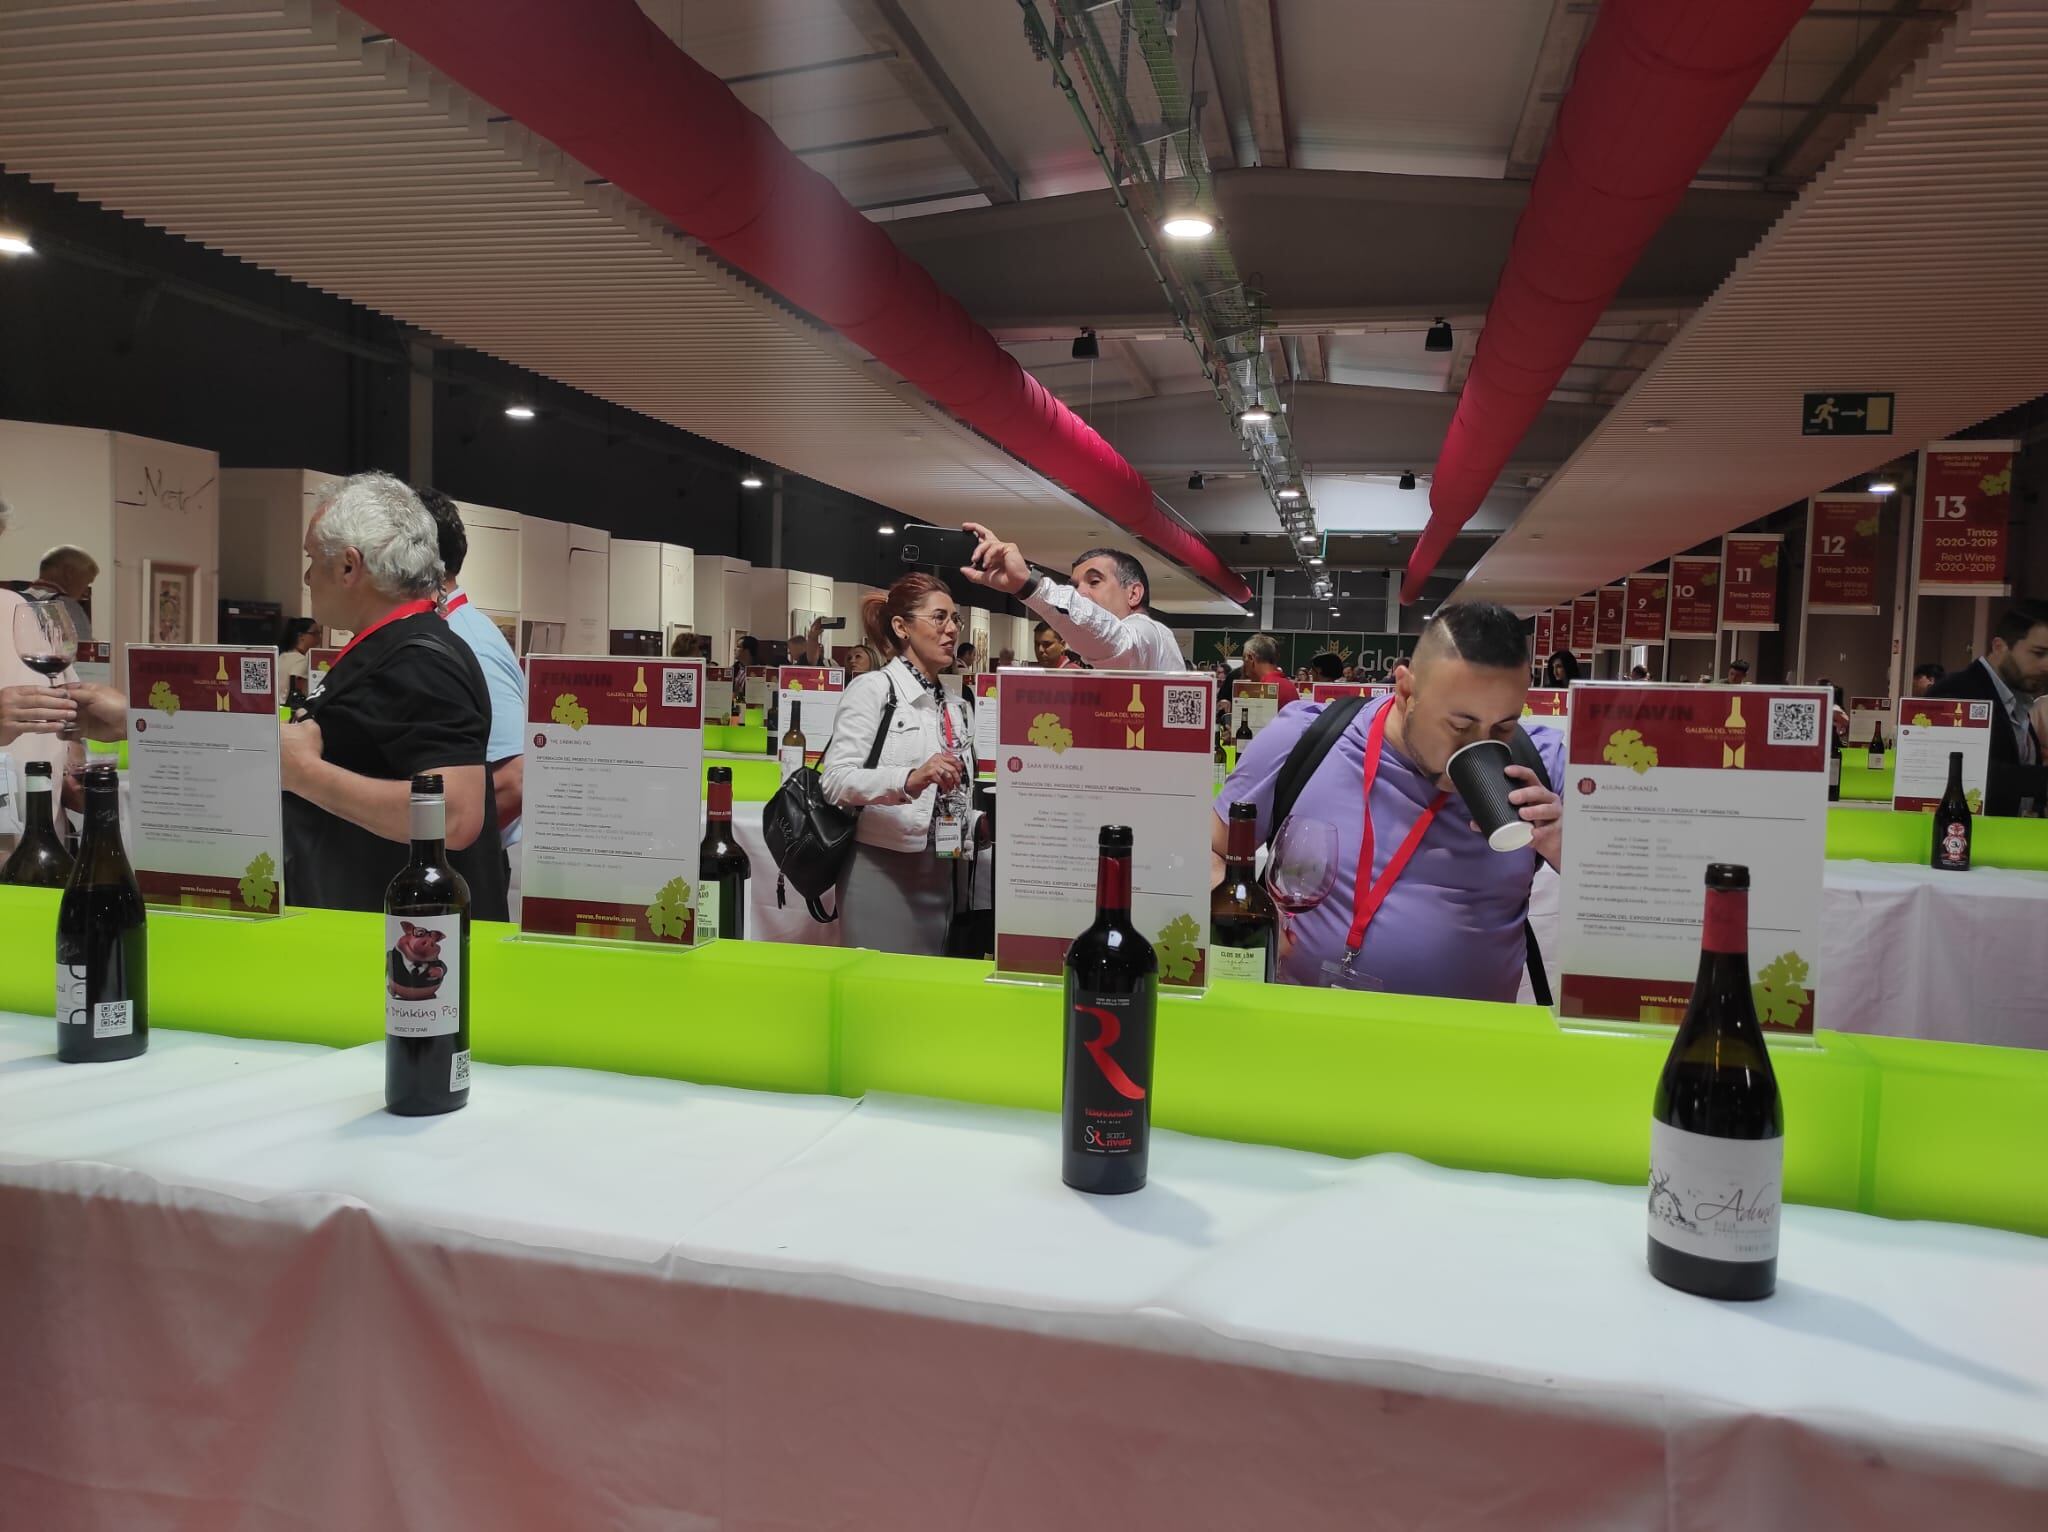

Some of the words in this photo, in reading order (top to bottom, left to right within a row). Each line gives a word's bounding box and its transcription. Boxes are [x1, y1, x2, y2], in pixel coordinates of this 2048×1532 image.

[1935, 495, 1967, 519] 13
[1967, 528, 1999, 538] Tintos
[1821, 535, 1846, 554] 12
[1936, 538, 1998, 547] 2020-2019
[1941, 553, 1962, 562] Red
[1964, 553, 1996, 562] Wines
[1817, 566, 1841, 574] Tintos
[1845, 566, 1869, 574] 2020
[1935, 562, 1996, 572] 2020-2019
[1736, 567, 1752, 582] 11
[1674, 584, 1695, 598] 10
[1638, 598, 1647, 609] 9
[1607, 608, 1615, 618] 8
[1582, 616, 1589, 625] 7
[1544, 629, 1550, 637] 5
[1016, 688, 1101, 706] FENAVIN
[1590, 703, 1695, 721] FENAVIN
[576, 913, 636, 923] www.fenavin.com
[1640, 994, 1689, 1005] www.fena
[441, 1004, 458, 1018] Pig
[1074, 1003, 1146, 1101] R
